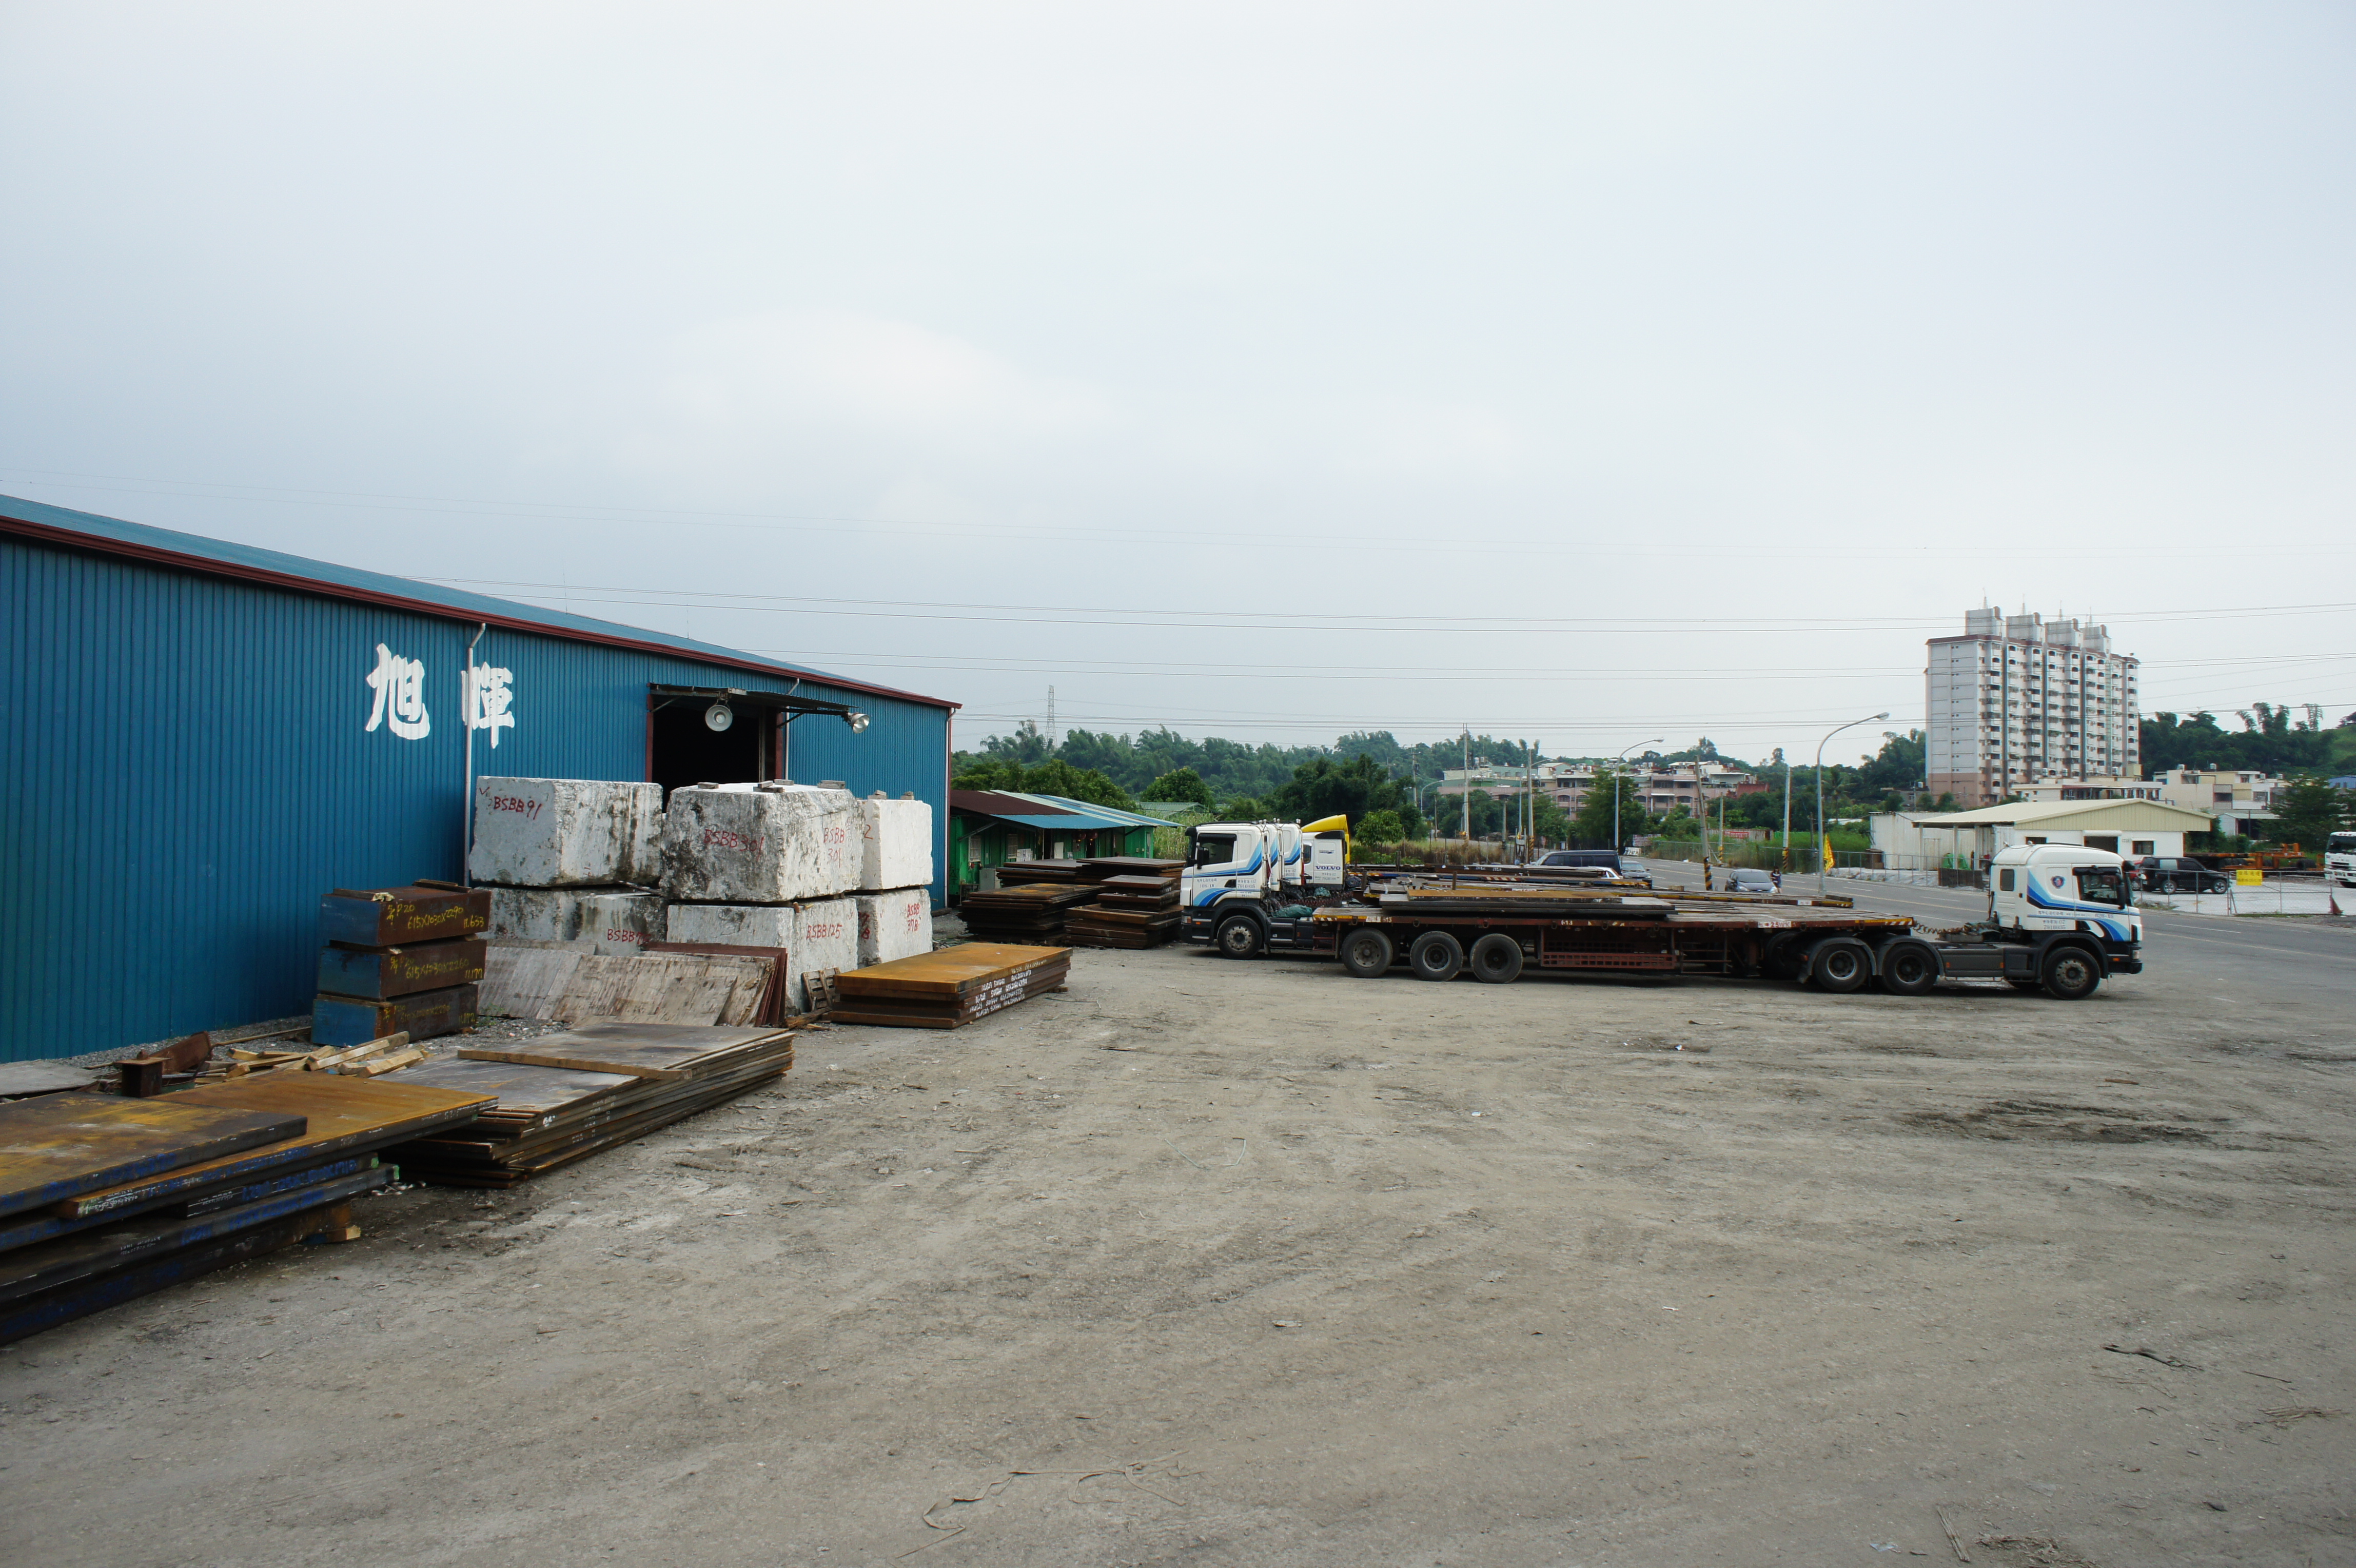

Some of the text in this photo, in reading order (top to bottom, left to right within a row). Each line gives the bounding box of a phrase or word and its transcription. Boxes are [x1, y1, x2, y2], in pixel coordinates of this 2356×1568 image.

[494, 796, 542, 820] BSBB91
[704, 829, 764, 861] BSBB301
[823, 828, 845, 844] BSBB
[827, 847, 841, 868] 301
[907, 903, 920, 917] BSBB
[807, 923, 842, 939] BSBB125
